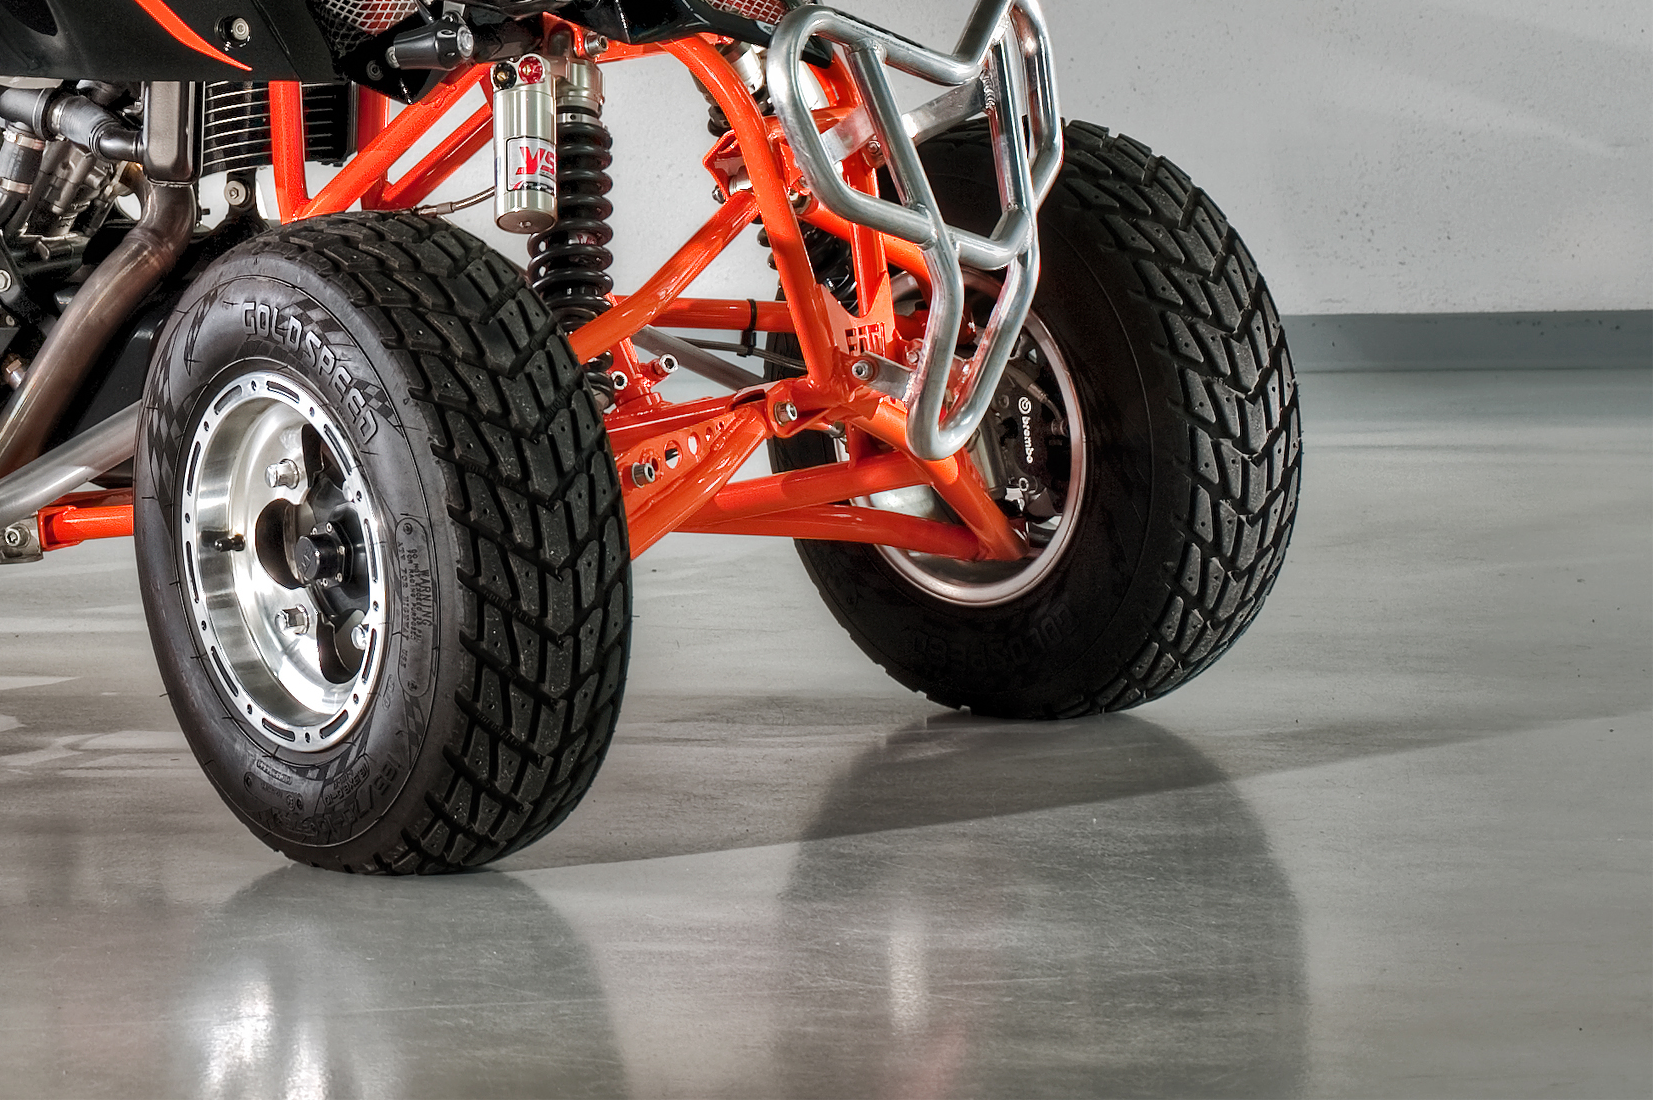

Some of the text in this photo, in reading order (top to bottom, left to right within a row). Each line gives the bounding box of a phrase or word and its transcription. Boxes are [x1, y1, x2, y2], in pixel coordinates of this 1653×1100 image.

[240, 301, 377, 445] GOLDSPEED
[1021, 416, 1034, 464] brembo
[418, 568, 433, 627] WARNING
